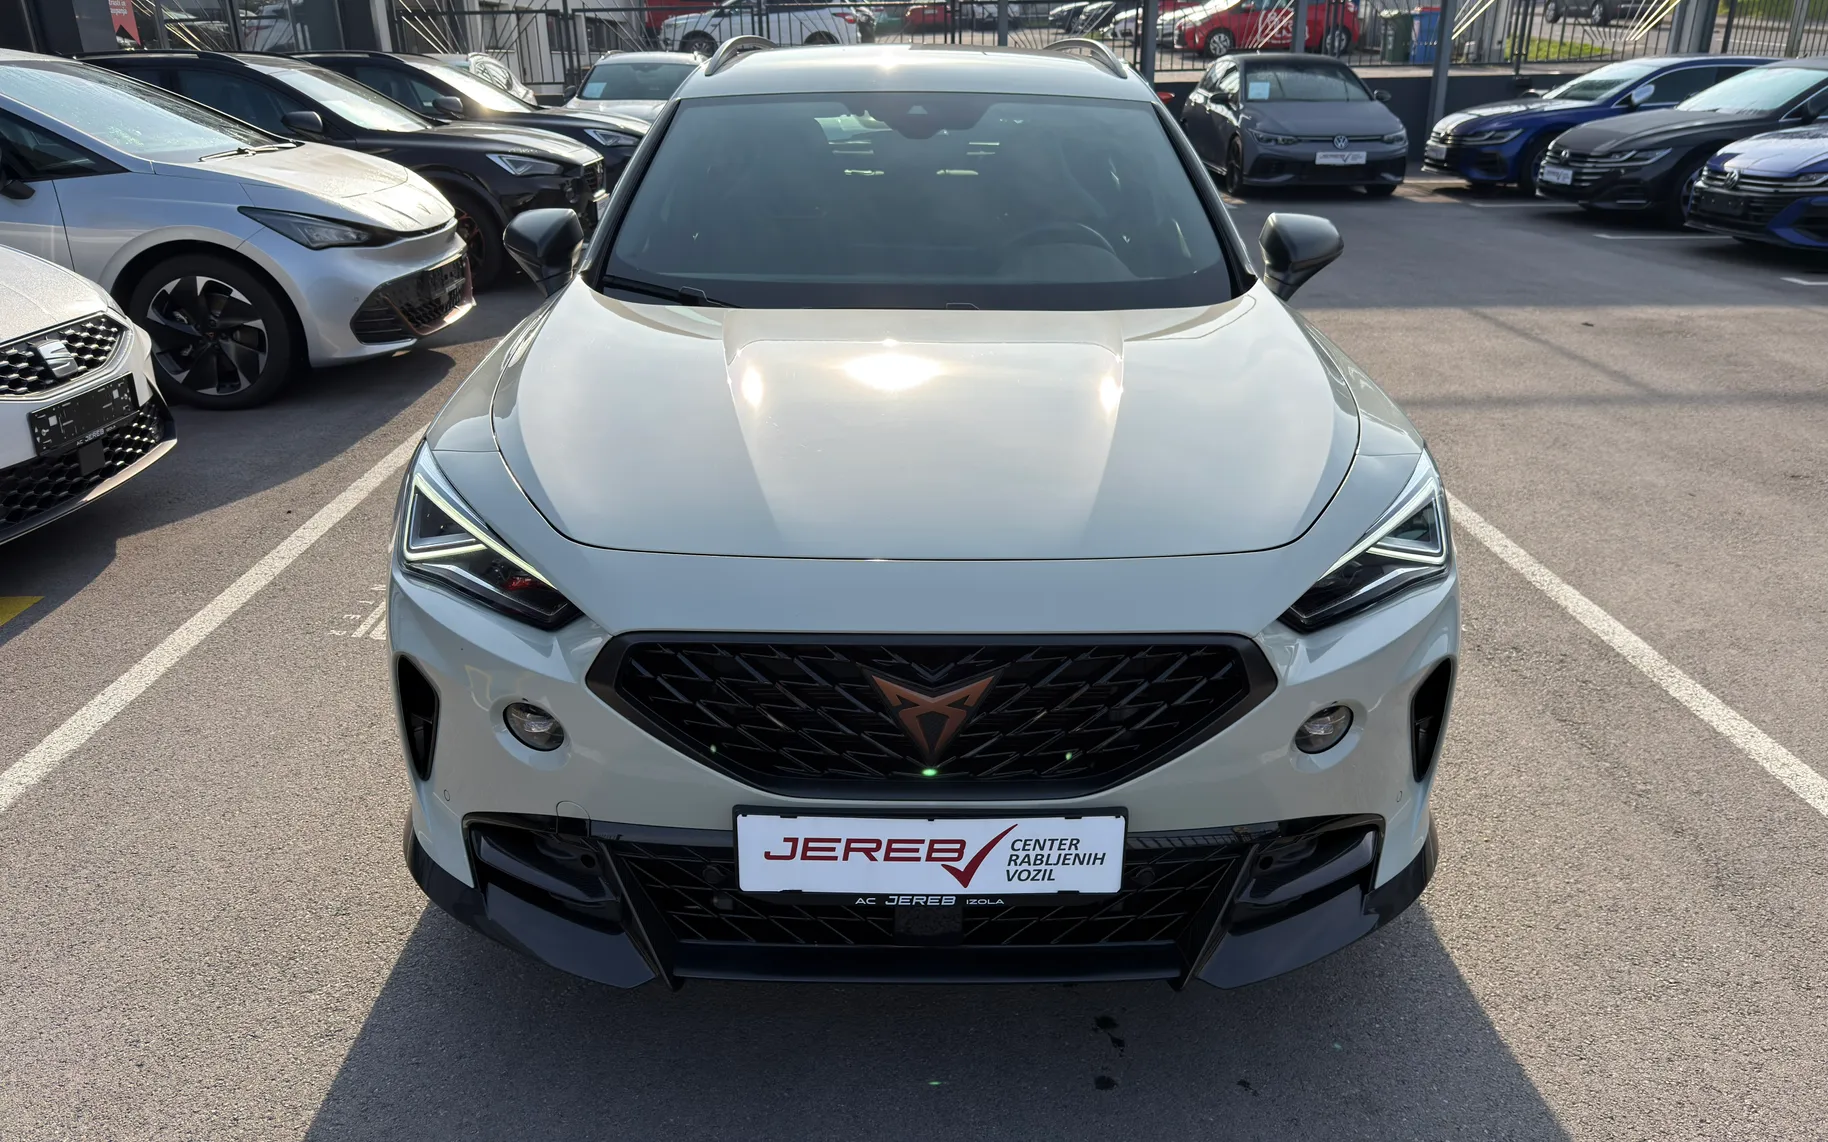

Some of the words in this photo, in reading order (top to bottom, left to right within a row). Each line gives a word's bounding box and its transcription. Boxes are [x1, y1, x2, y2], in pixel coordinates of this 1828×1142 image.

[763, 837, 966, 862] JEREB
[1010, 838, 1081, 852] CENTER
[1007, 852, 1106, 866] RABLJENIH
[1005, 868, 1056, 882] VOZIL
[855, 897, 877, 905] AC
[885, 895, 956, 906] JEREB
